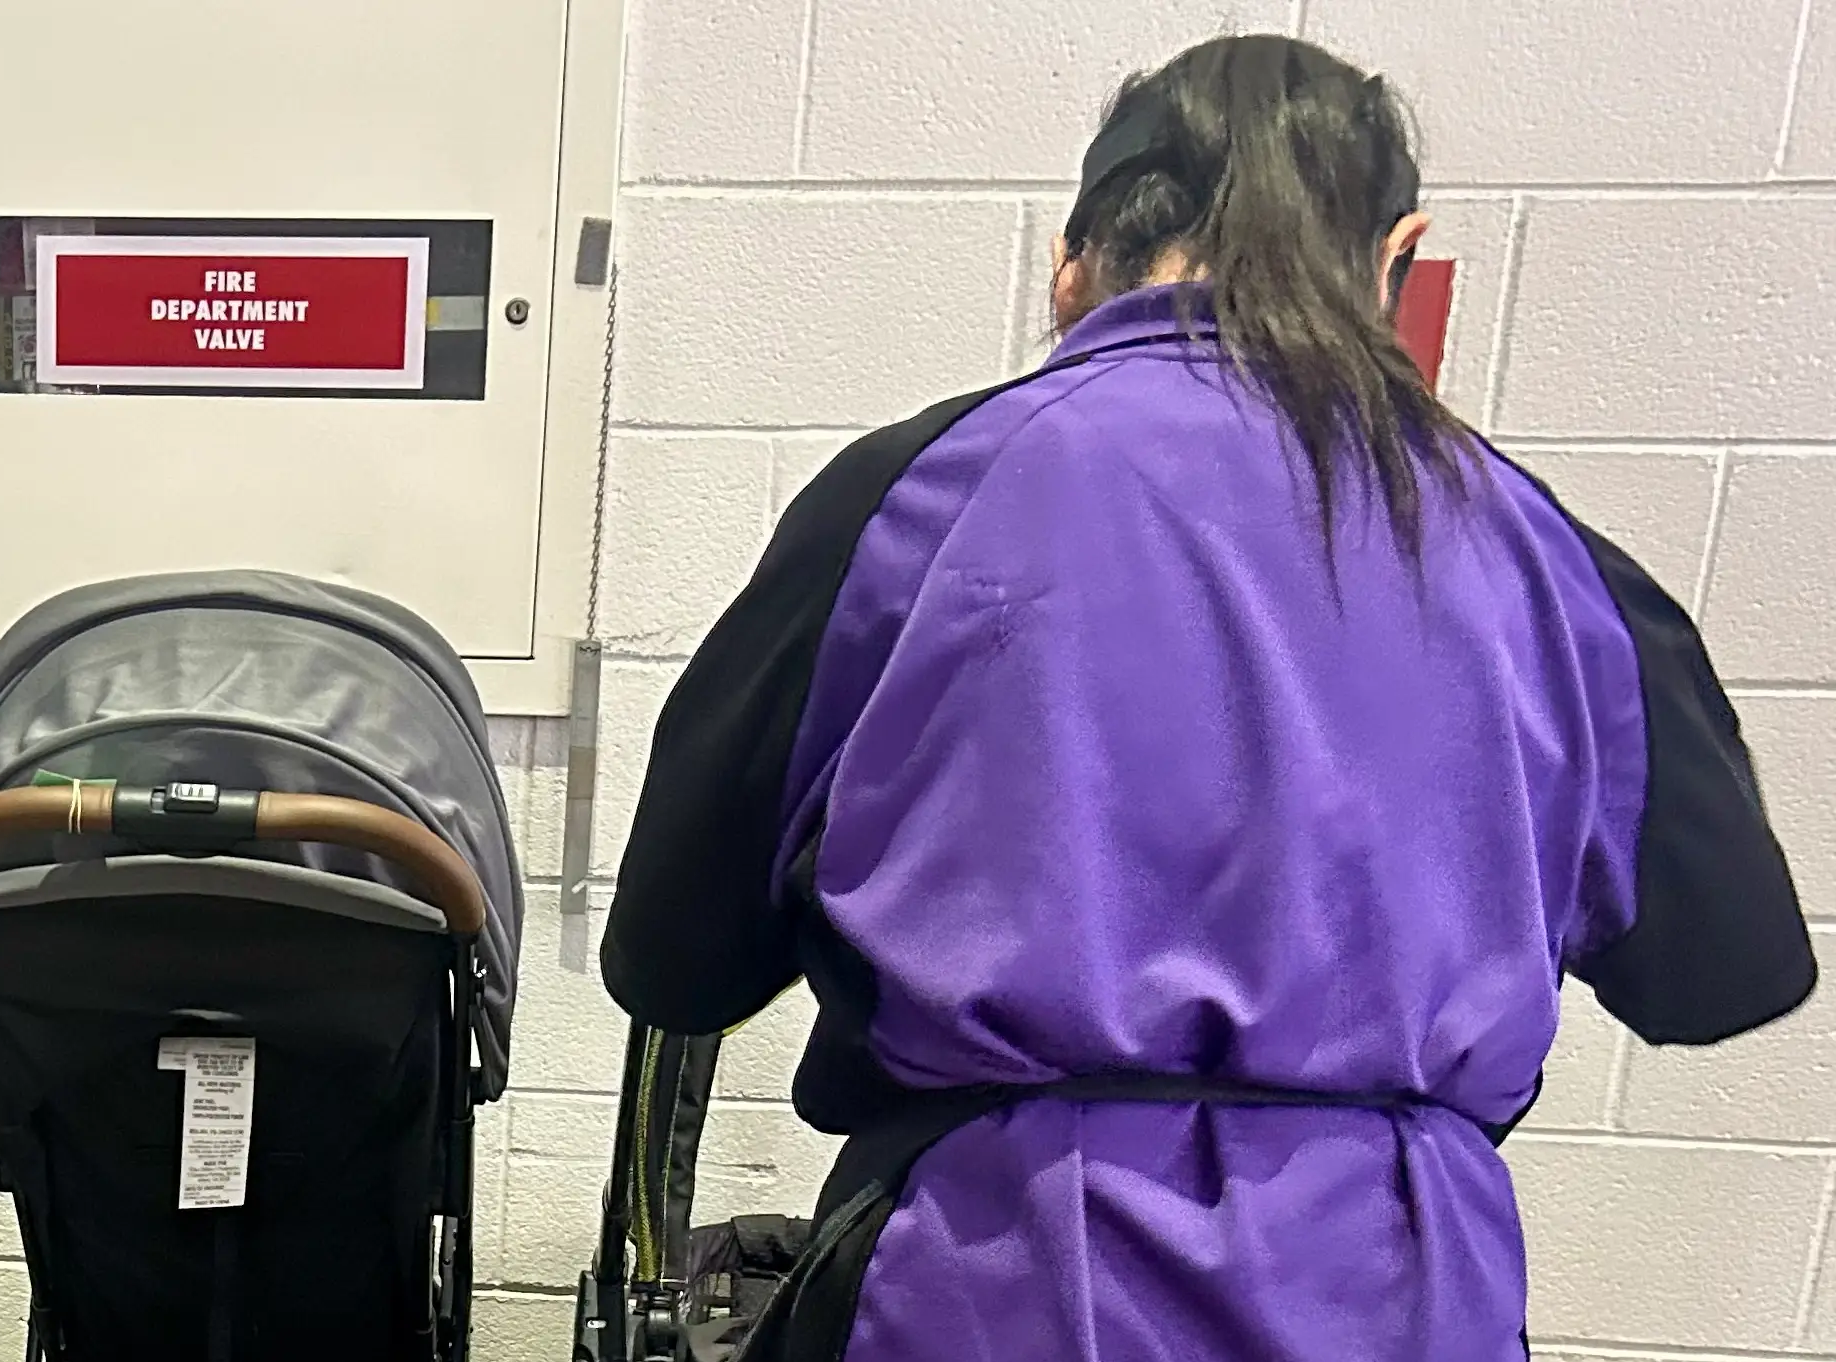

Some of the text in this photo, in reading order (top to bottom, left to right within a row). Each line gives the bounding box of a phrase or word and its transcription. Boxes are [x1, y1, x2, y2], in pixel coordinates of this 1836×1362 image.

[204, 270, 256, 292] FIRE
[151, 299, 308, 322] DEPARTMENT
[194, 328, 265, 350] VALVE
